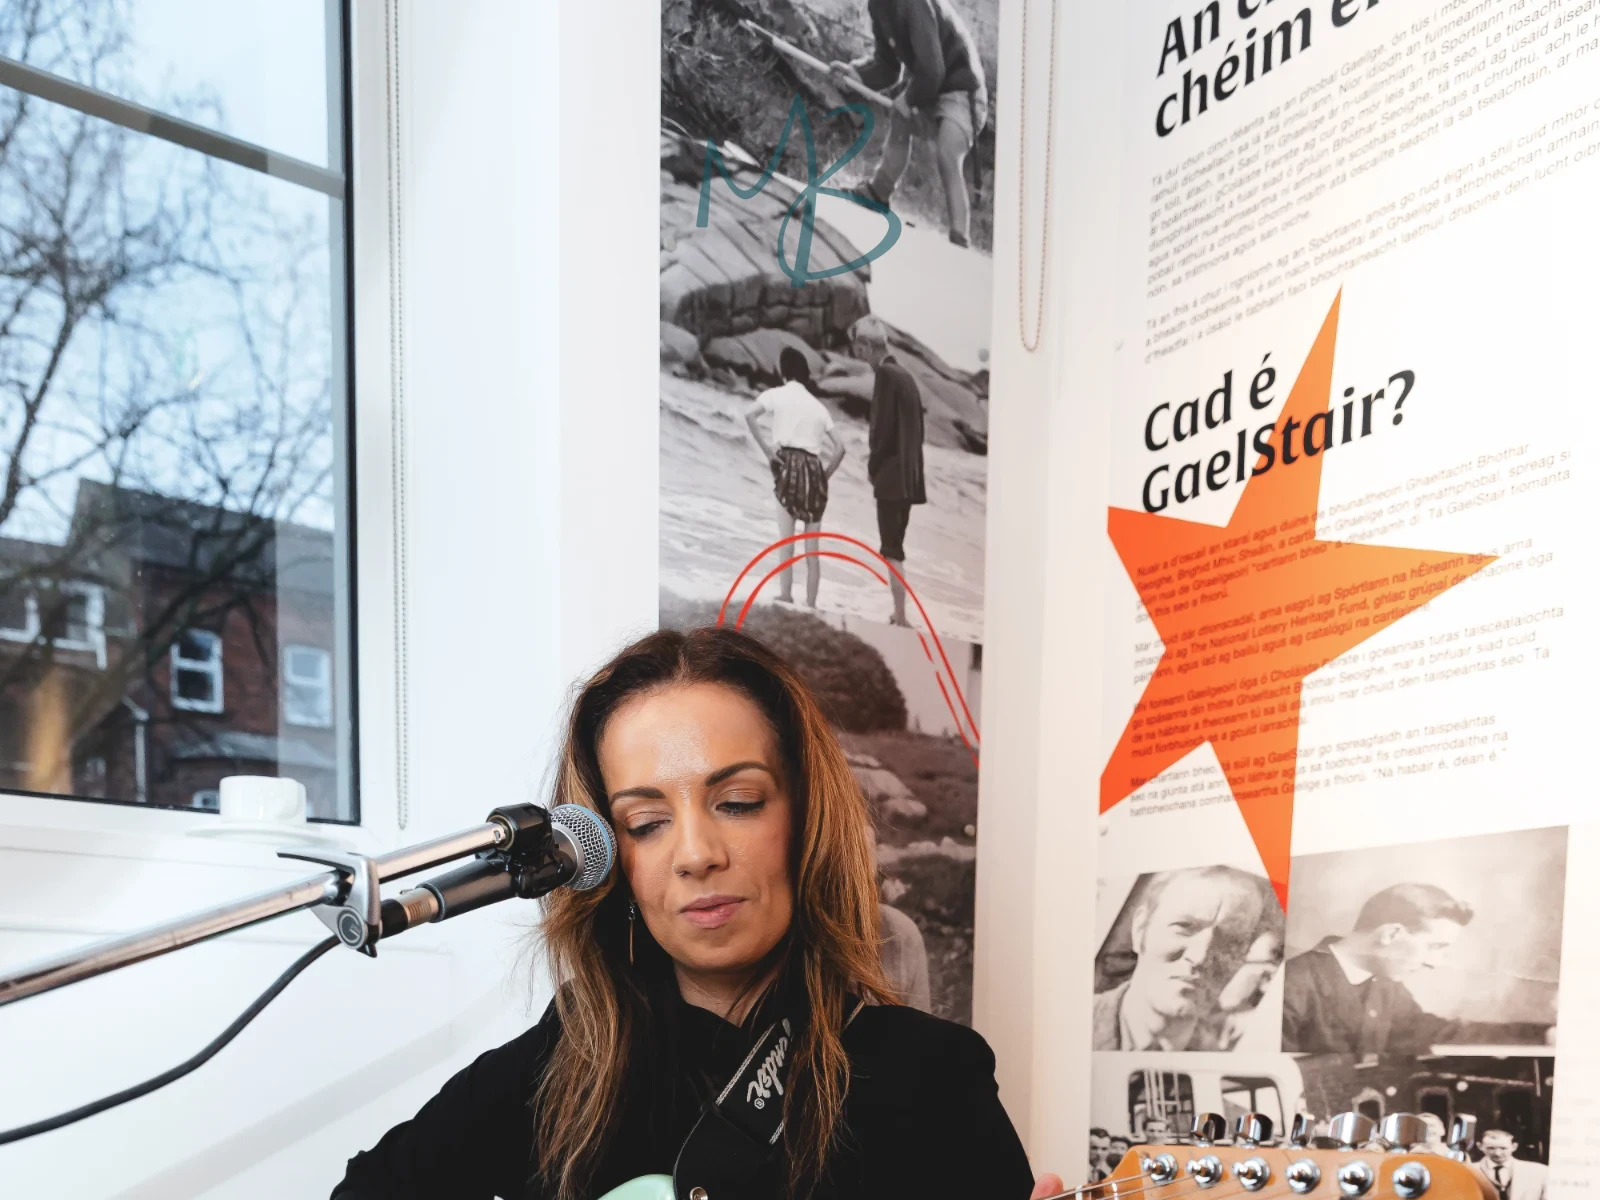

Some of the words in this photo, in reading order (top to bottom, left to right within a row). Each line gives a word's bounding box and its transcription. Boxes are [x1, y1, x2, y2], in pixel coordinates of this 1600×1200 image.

[1156, 0, 1220, 79] An
[1156, 7, 1312, 138] chéim
[1142, 369, 1416, 515] GaelStair?
[1144, 369, 1234, 452] Cad
[1249, 352, 1277, 411] é
